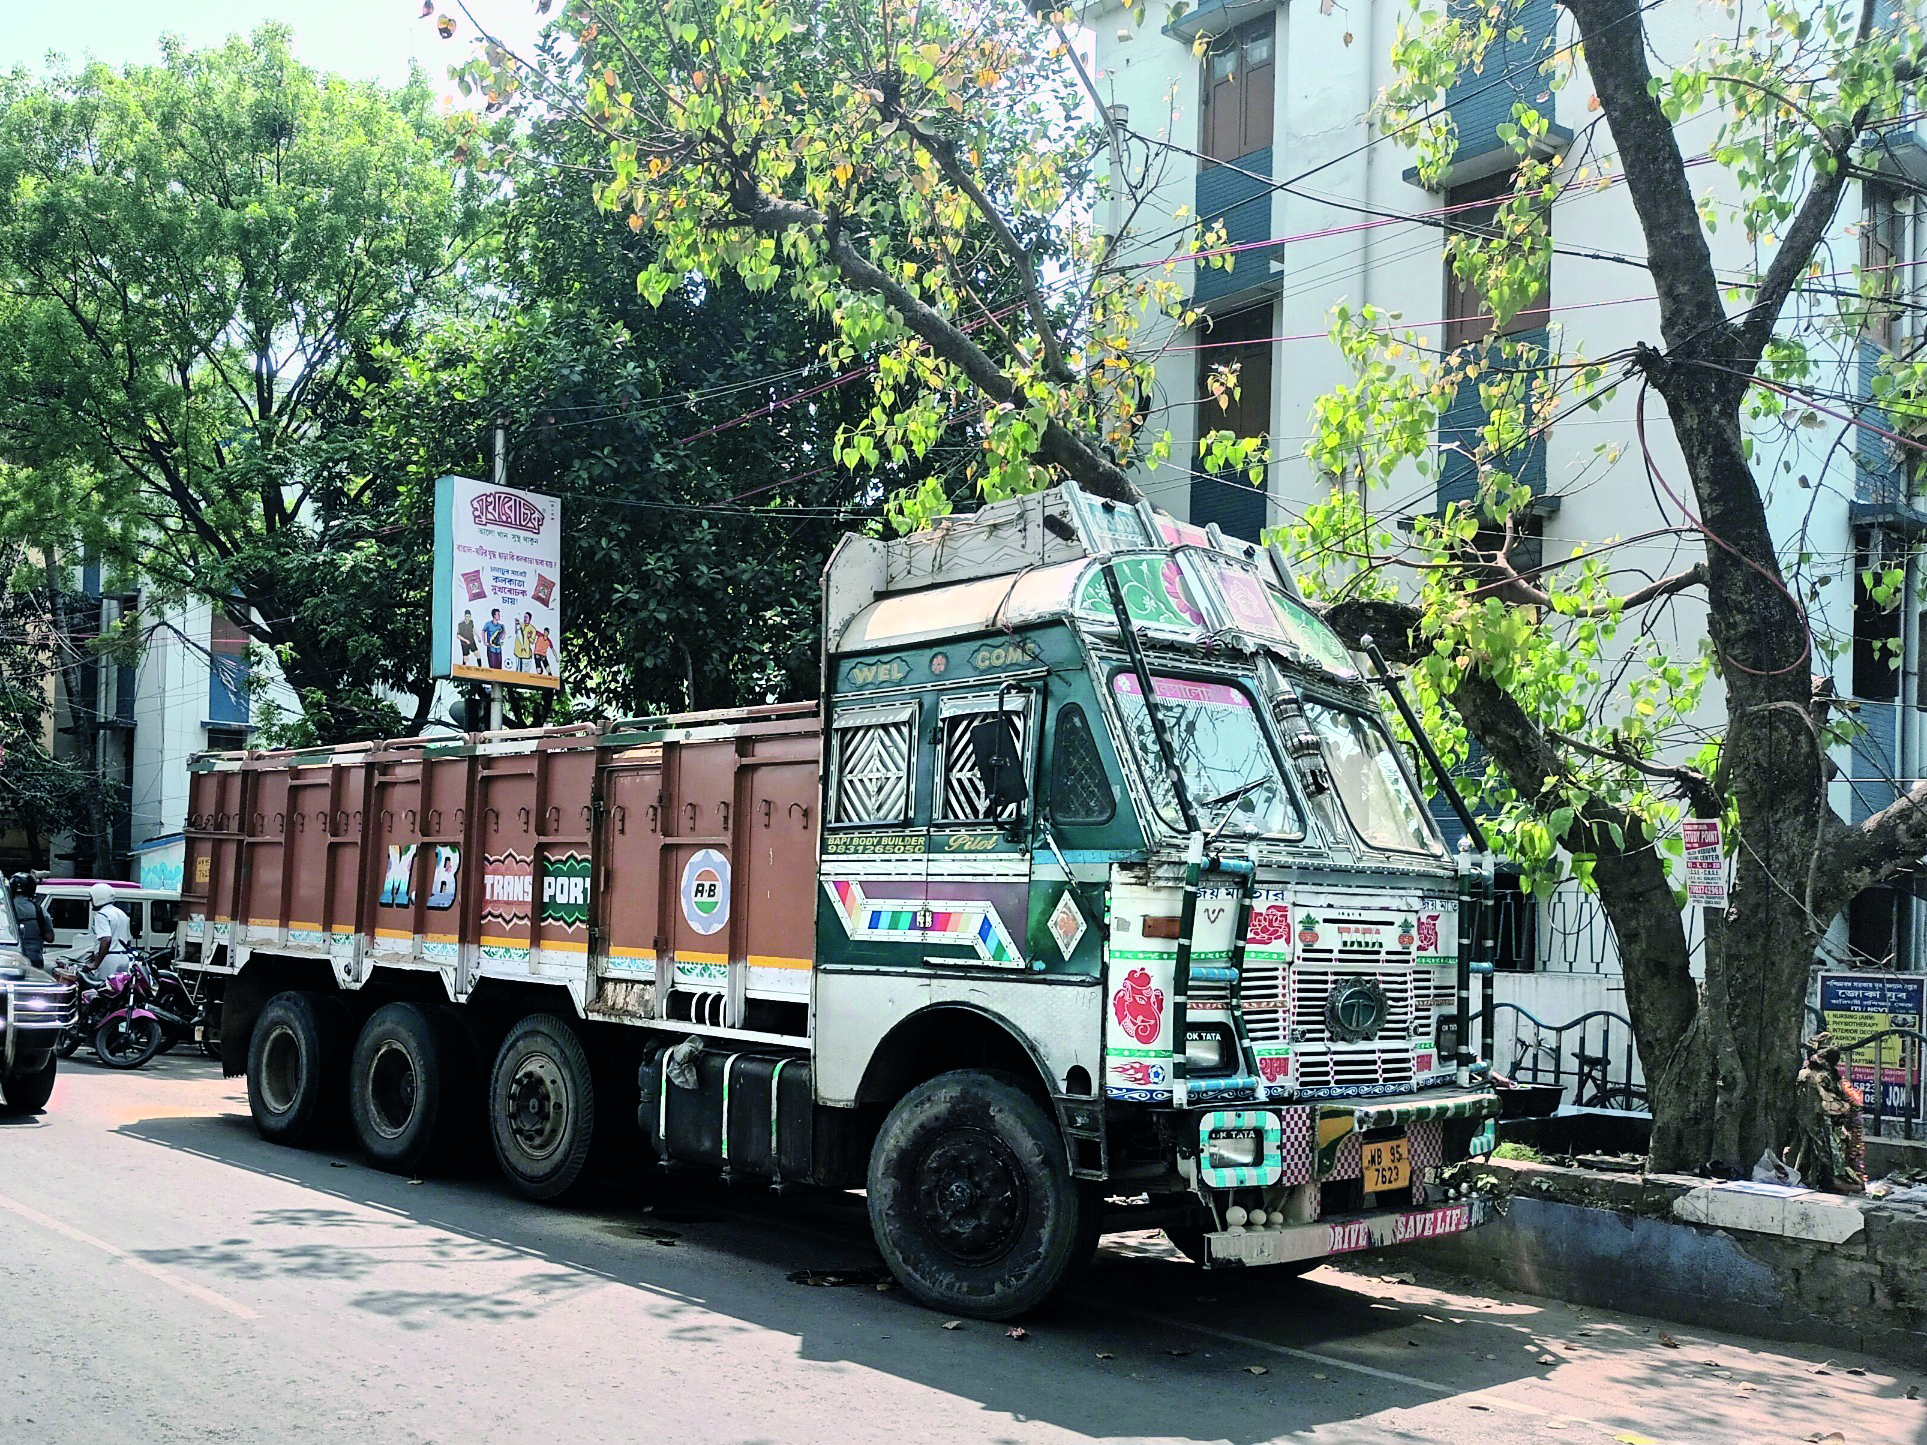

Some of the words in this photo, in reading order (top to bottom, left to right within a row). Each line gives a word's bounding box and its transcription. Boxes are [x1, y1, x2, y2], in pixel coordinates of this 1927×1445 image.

[470, 491, 545, 535] মুখরোচক
[976, 643, 1035, 668] COME
[853, 663, 904, 684] WEL
[827, 844, 925, 853] 9831265050
[828, 836, 850, 845] BAPI
[852, 836, 878, 845] BODY
[881, 836, 925, 845] BUILDER
[944, 834, 999, 851] Pilot
[484, 874, 533, 902] TRANS
[1337, 926, 1384, 949] TATA
[1832, 1020, 1879, 1028] PHYSIOTHERAPY
[1186, 1032, 1200, 1040] OK
[1201, 1032, 1222, 1041] TATA
[1886, 1084, 1915, 1108] JOK
[1230, 1130, 1256, 1139] TATA
[1370, 1148, 1382, 1167] WB
[1390, 1145, 1402, 1163] 95
[1375, 1165, 1400, 1187] 7623
[1397, 1212, 1435, 1240] SAVE
[1436, 1206, 1469, 1234] LIFE
